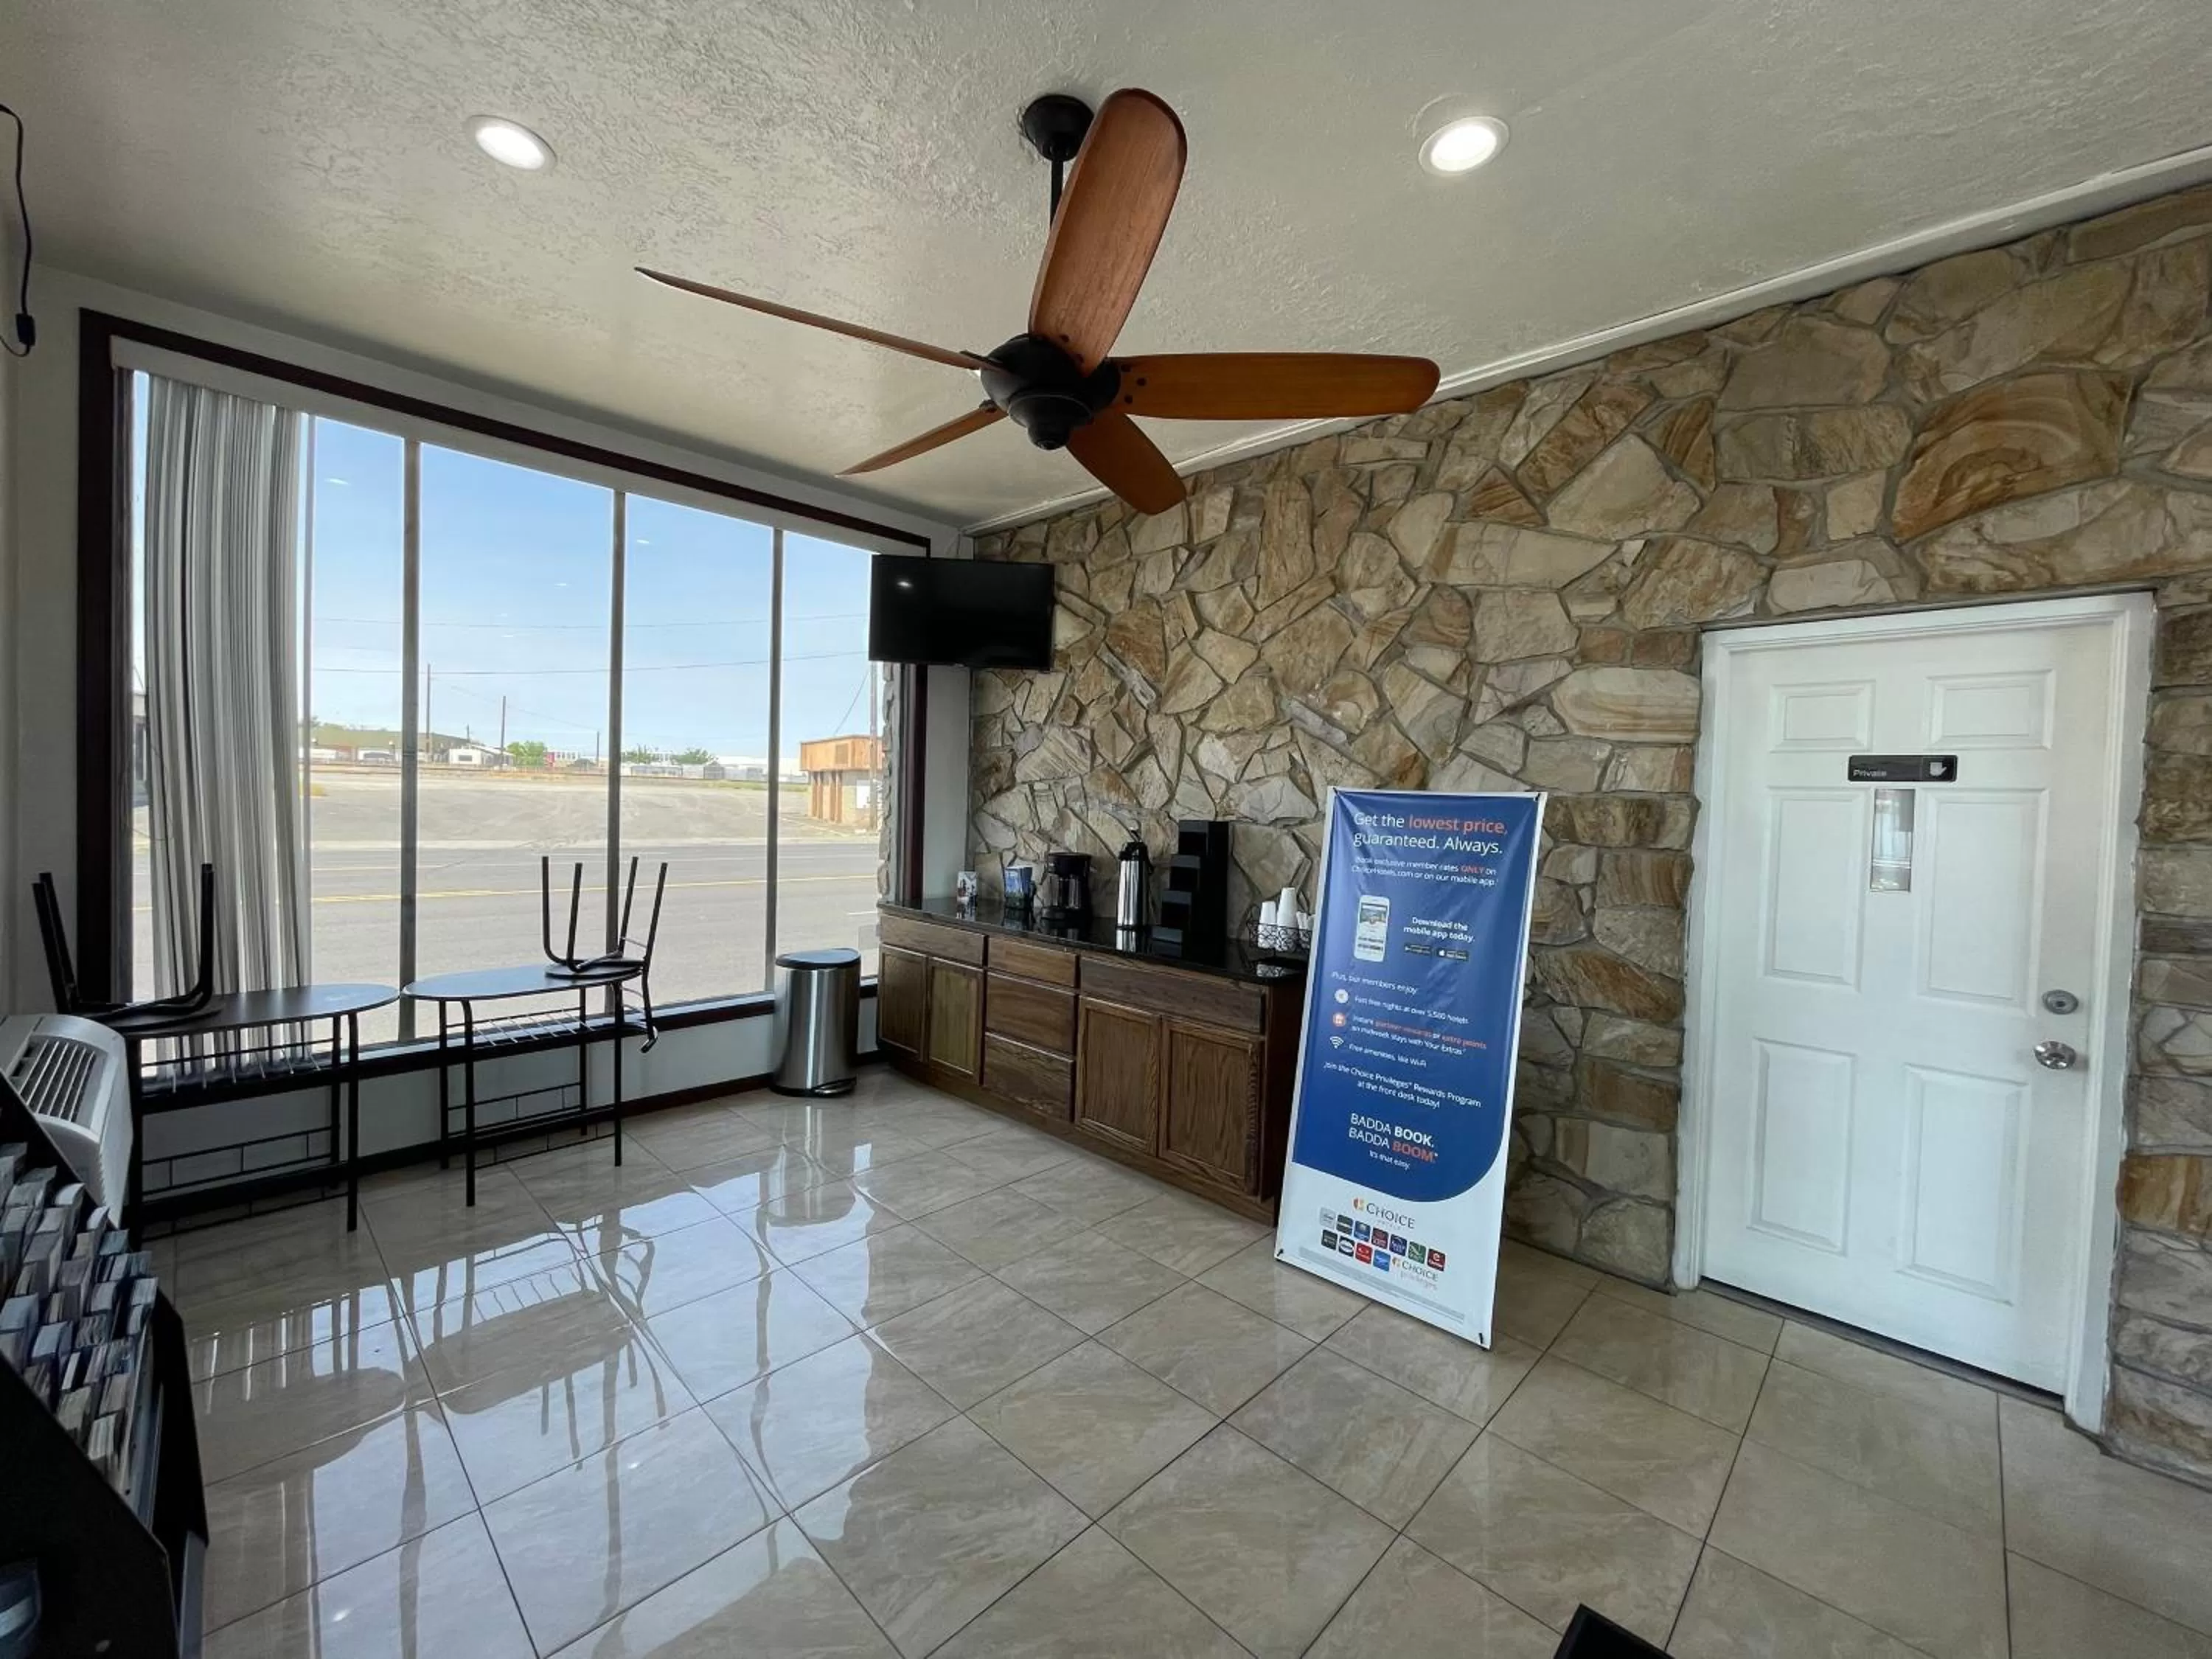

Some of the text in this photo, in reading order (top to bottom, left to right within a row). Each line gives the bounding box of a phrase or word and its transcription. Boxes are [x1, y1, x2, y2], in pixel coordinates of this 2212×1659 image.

[1353, 812, 1508, 835] Get the lowest price,
[1353, 832, 1503, 857] guaranteed. Always.
[1374, 857, 1406, 867] exclusive
[1406, 860, 1438, 870] member
[1439, 863, 1458, 872] rates
[1461, 865, 1485, 874] ONLY
[1485, 868, 1496, 876] on
[1424, 872, 1434, 880] on
[1436, 874, 1449, 882] our
[1450, 875, 1477, 885] mobile
[1403, 926, 1475, 944] mobile app today.
[1412, 917, 1468, 931] Download the
[1362, 977, 1396, 990] members
[1411, 1007, 1425, 1016] over
[1324, 1061, 1338, 1070] Join
[1338, 1064, 1350, 1073] the
[1351, 1067, 1374, 1079] Choice
[1413, 1083, 1445, 1098] Rewards
[1447, 1091, 1481, 1107] Program
[1365, 1082, 1378, 1092] the
[1378, 1085, 1397, 1096] front
[1397, 1091, 1416, 1104] desk
[1348, 1127, 1390, 1149] BADDA
[1350, 1113, 1434, 1148] BADDA BOOK.
[1379, 1152, 1392, 1164] that
[1366, 1202, 1416, 1229] CHOICE
[1402, 1259, 1439, 1281] CHOICE
